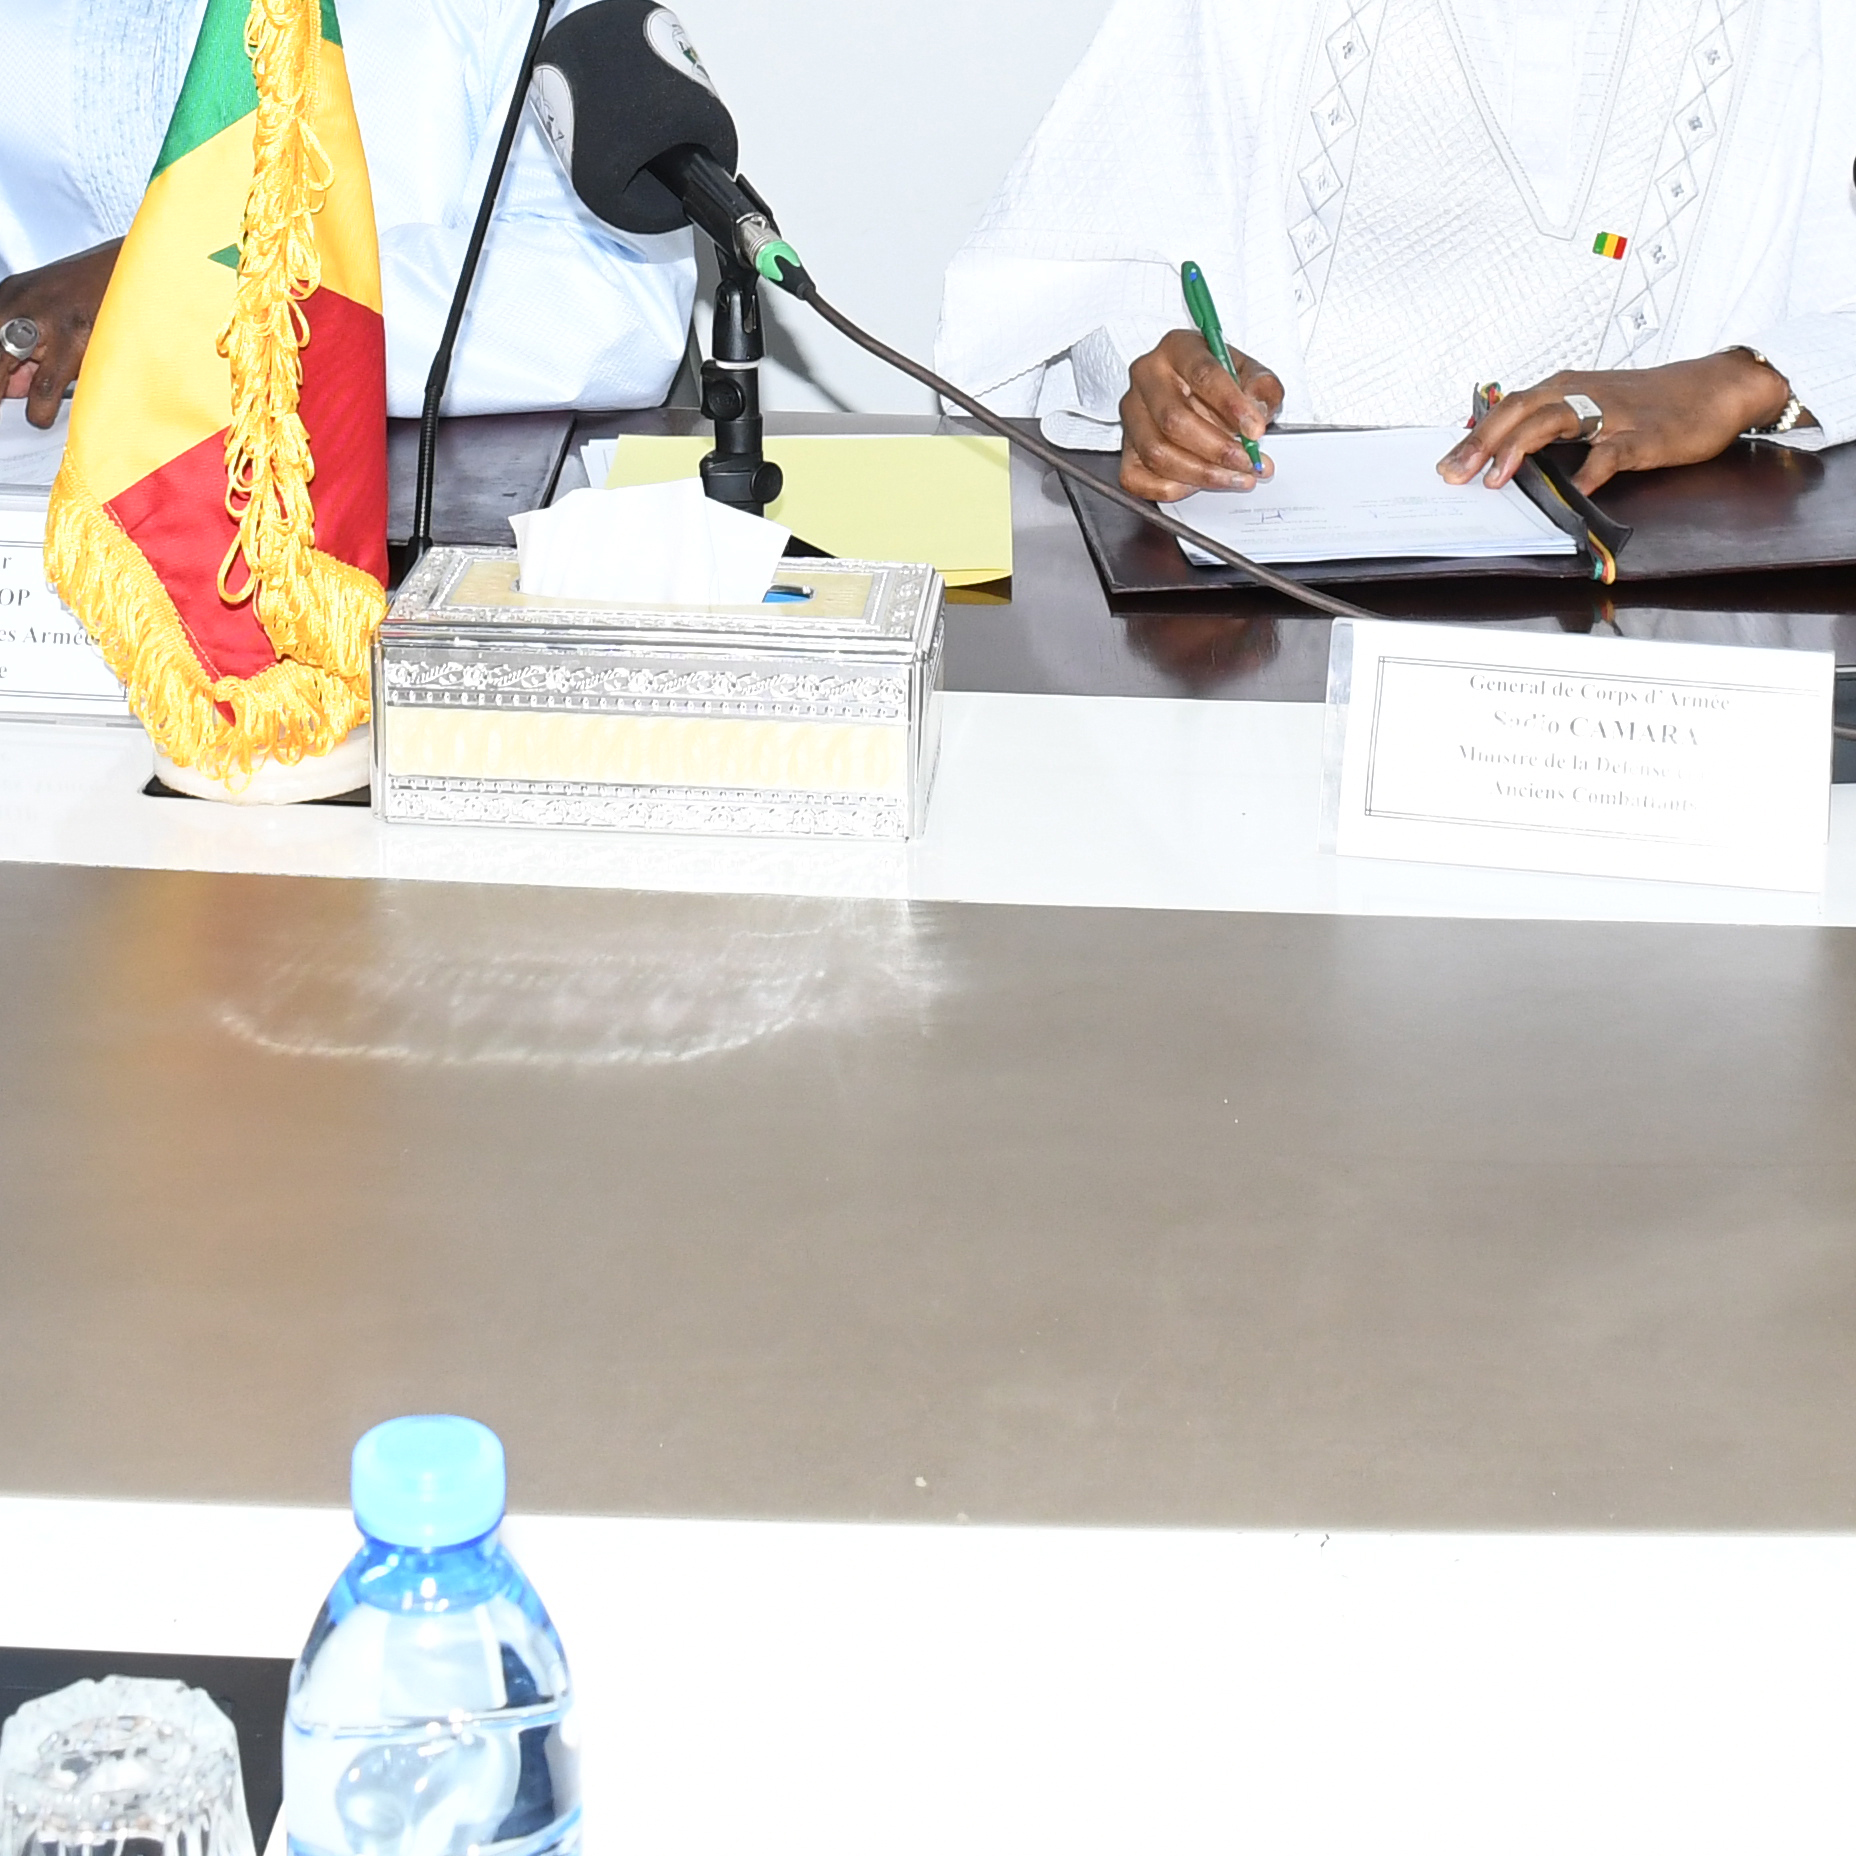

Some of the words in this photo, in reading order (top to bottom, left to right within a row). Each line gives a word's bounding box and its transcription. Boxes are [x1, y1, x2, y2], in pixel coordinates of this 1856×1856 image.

[1469, 673, 1546, 695] General
[1552, 681, 1574, 698] de
[1580, 682, 1639, 707] Corps
[1568, 715, 1700, 746] CAMARA
[1458, 744, 1539, 767] Ministre
[1544, 752, 1566, 769] de
[1573, 754, 1589, 771] la
[1490, 779, 1566, 802] Anciens
